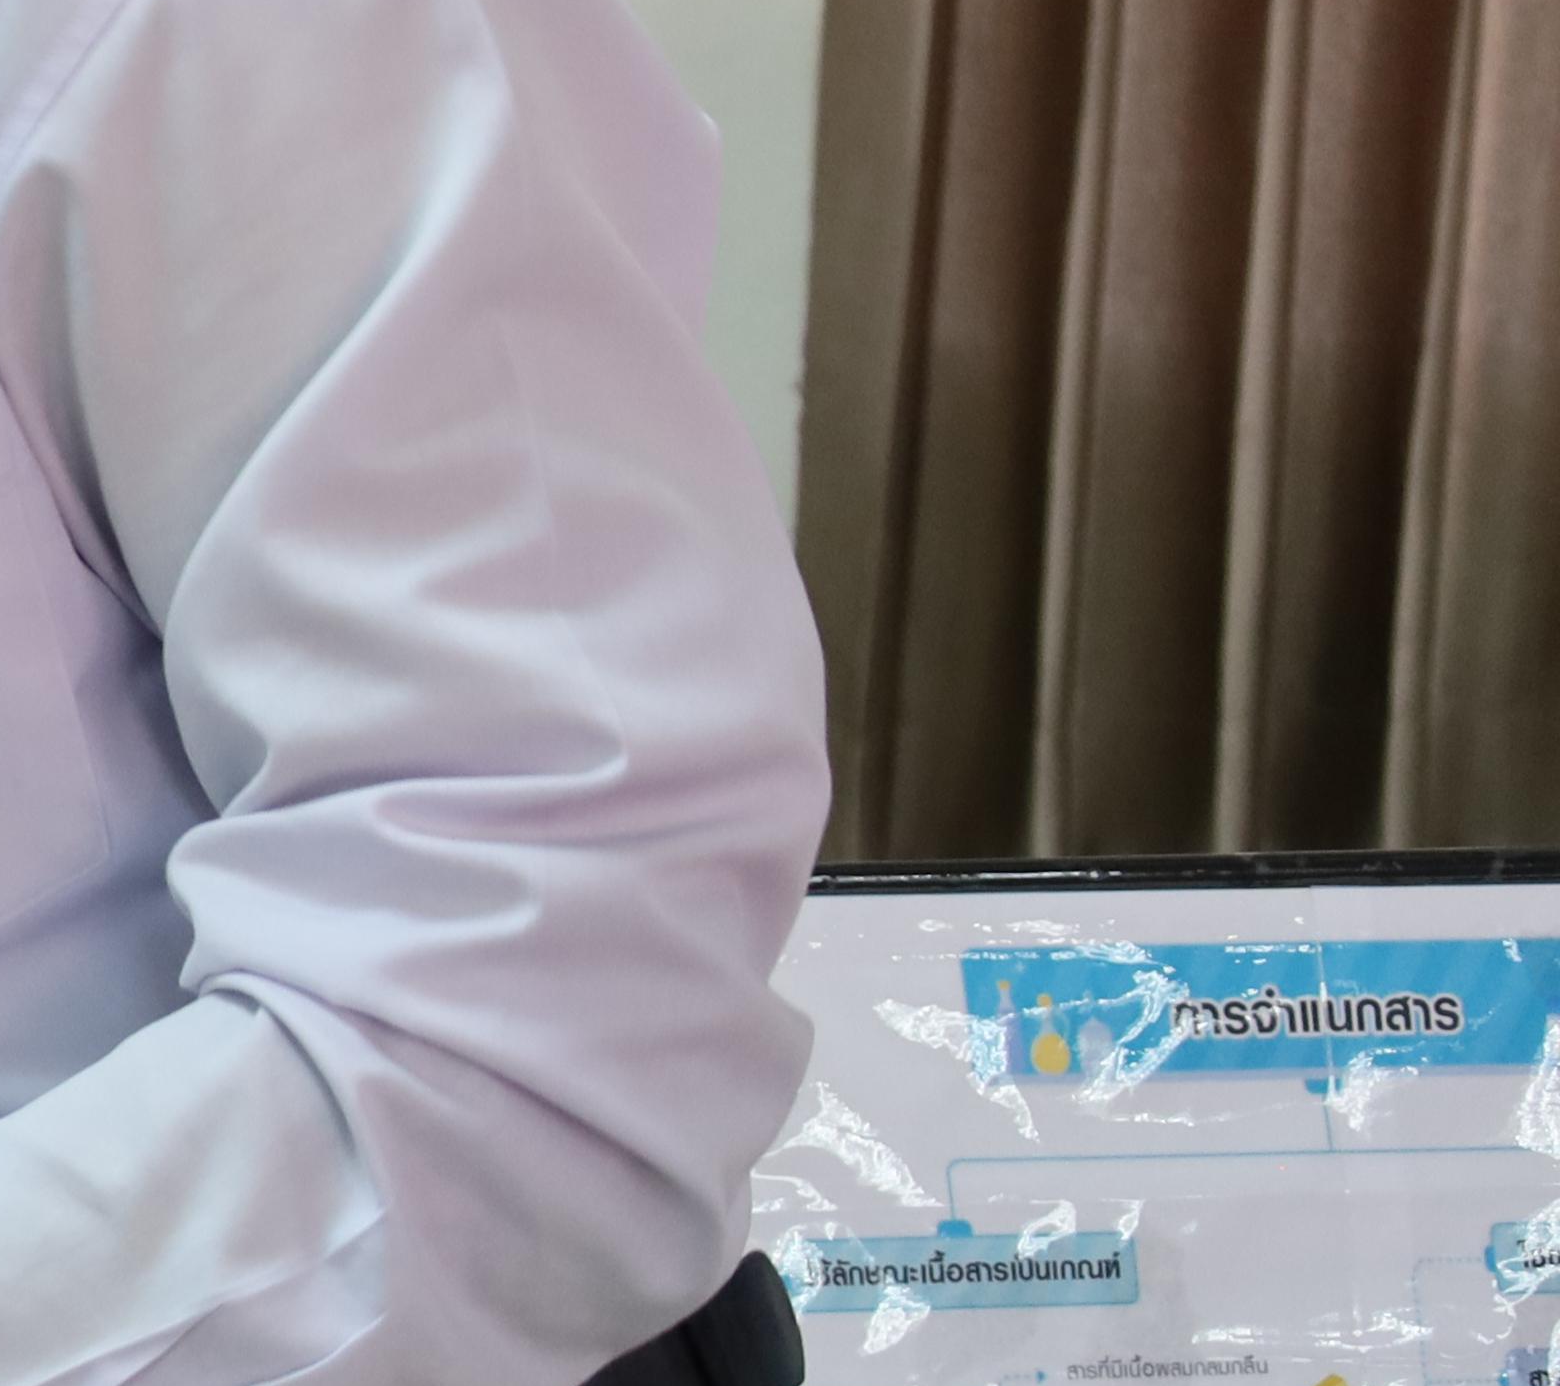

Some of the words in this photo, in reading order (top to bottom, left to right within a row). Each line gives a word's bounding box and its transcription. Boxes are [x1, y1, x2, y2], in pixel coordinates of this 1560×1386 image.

[1174, 986, 1463, 1037] การจำแนกสาร
[804, 1250, 1121, 1287] ช้ลักษณะเนื้อสารเป็นเกณฑ์
